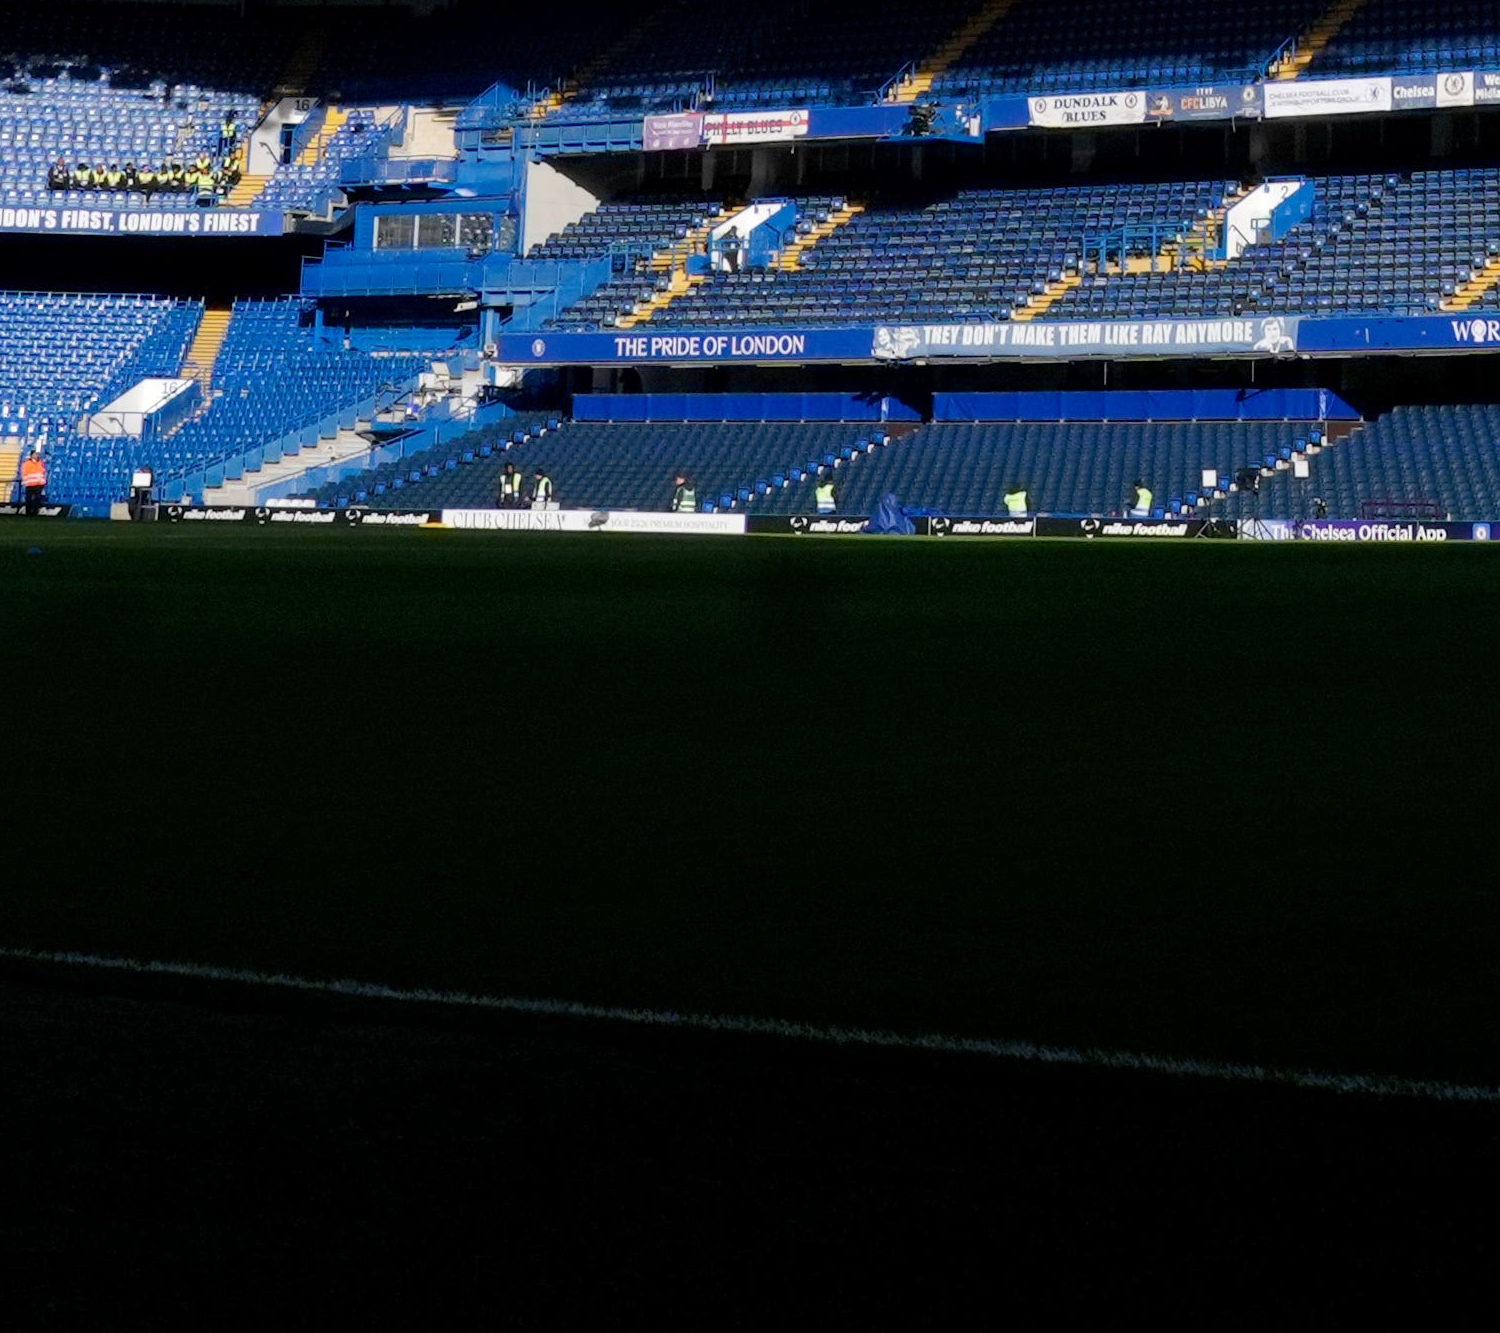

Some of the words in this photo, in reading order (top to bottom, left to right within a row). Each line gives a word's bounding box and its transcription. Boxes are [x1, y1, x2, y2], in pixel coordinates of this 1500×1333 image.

[1394, 85, 1435, 98] Chelsea
[295, 99, 309, 111] 16
[1054, 95, 1118, 109] DUNDALK
[1064, 110, 1107, 123] BLUES
[747, 119, 783, 134] BLUES
[61, 209, 115, 232] FIRST,
[118, 209, 200, 232] LONDON'S
[204, 211, 261, 232] FINEST
[924, 326, 958, 345] THEY
[962, 325, 1009, 345] DON'T
[1011, 325, 1054, 346] MAKE
[1059, 324, 1101, 345] THEM
[1105, 324, 1138, 345] LIKE
[1142, 323, 1172, 344] RAY
[1175, 322, 1253, 344] ANYMORE
[615, 337, 647, 356] THE
[651, 336, 700, 356] PRIDE
[703, 336, 728, 355] OF
[732, 335, 805, 355] LONDON
[163, 381, 178, 394] 16
[183, 509, 204, 520] nike
[204, 510, 246, 521] football
[271, 510, 294, 521] nike
[294, 510, 336, 522] football
[362, 512, 385, 523] nike
[385, 511, 430, 524] football
[452, 512, 491, 530] CLUB
[495, 512, 564, 531] CHELSEA
[650, 520, 681, 529] PREMIUM
[683, 521, 728, 530] HOSPITALITY
[809, 521, 836, 532] nike
[953, 522, 979, 533] nike
[980, 521, 1033, 534] football
[1103, 524, 1130, 536] nike
[1130, 523, 1188, 536] football
[1302, 524, 1357, 541] Chelsea
[1360, 524, 1414, 541] Official
[1416, 525, 1447, 543] App
